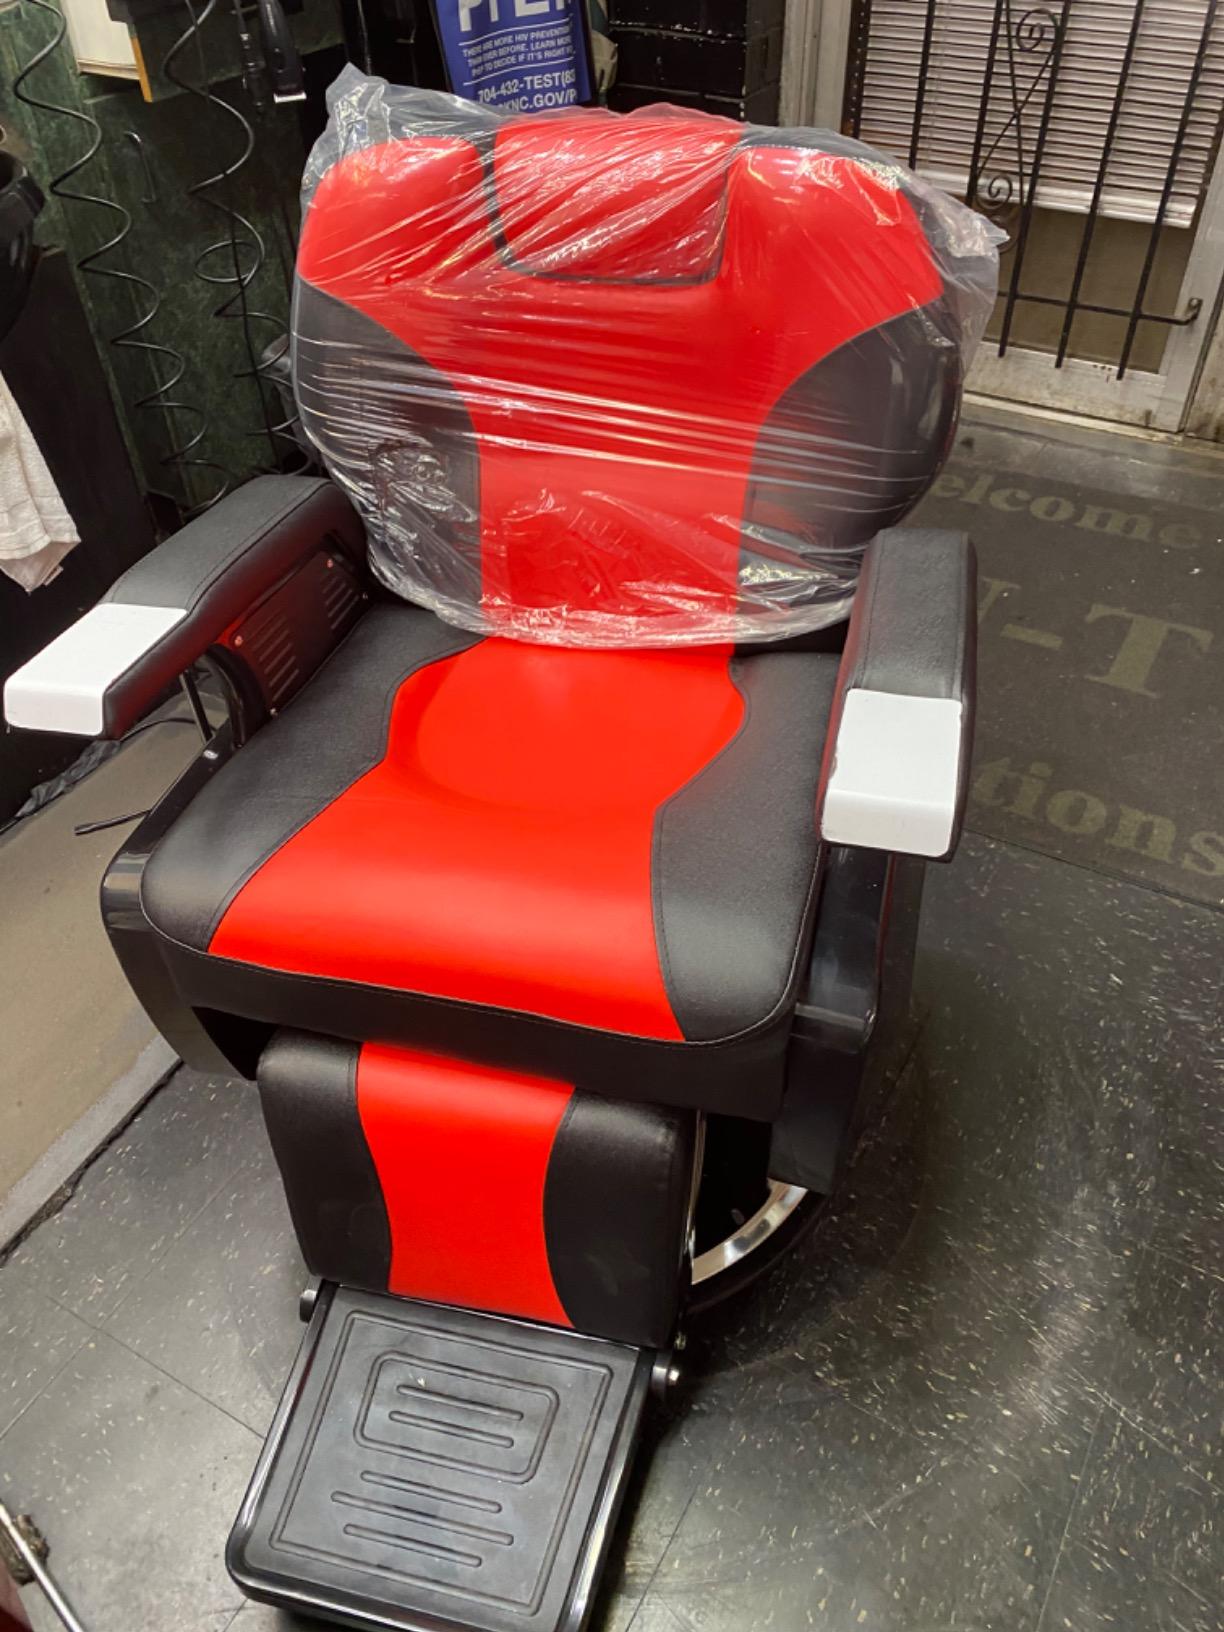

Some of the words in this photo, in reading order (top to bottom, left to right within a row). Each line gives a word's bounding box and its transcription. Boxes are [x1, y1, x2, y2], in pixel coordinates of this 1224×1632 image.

[493, 35, 514, 49] MORE
[514, 33, 528, 42] HIV
[498, 43, 529, 56] BEFORE.
[530, 39, 556, 50] LEARN
[493, 55, 517, 68] DECIDE
[517, 53, 525, 62] IF
[527, 51, 543, 61] IT'S
[544, 47, 565, 59] RIGHT
[930, 470, 1201, 549] elcome
[970, 758, 1224, 876] tions
